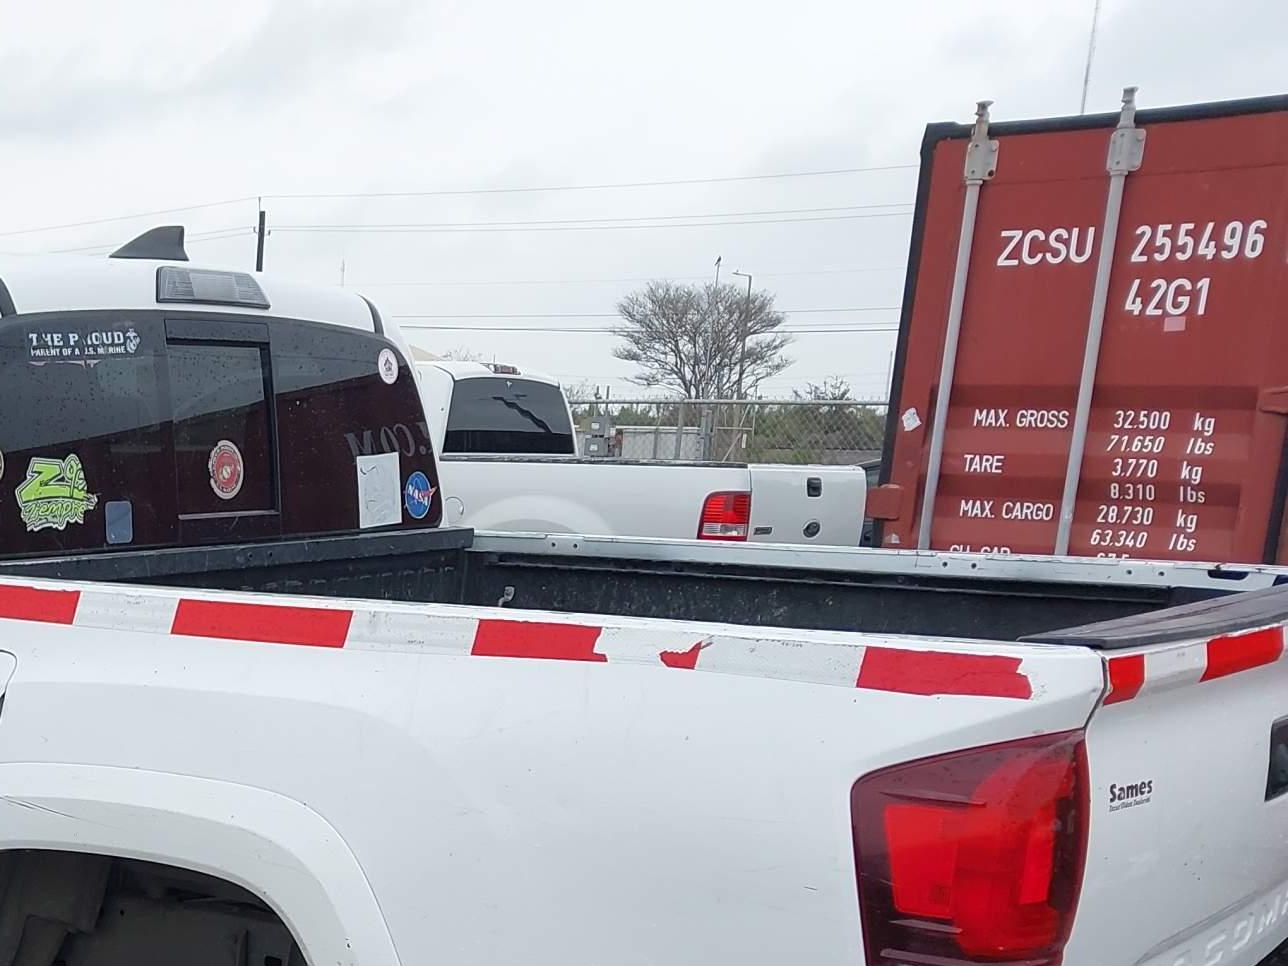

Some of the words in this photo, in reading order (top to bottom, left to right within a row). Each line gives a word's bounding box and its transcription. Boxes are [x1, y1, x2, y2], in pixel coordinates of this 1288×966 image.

[996, 226, 1096, 267] ZCSU
[1130, 219, 1268, 263] 255496
[1124, 277, 1211, 316] 42G1
[972, 408, 1010, 428] MAX.
[1015, 409, 1070, 429] GROSS
[1113, 410, 1171, 430] 32.500
[1193, 412, 1215, 436] kg
[1106, 434, 1165, 453] 71.650
[1186, 437, 1215, 455] lbs
[963, 454, 1005, 473] TARE
[1111, 458, 1158, 478] 3.770
[1180, 460, 1203, 485] kg
[407, 483, 429, 506] NASA
[1110, 482, 1155, 501] 8.310
[1179, 485, 1206, 504] lbs
[959, 499, 995, 518] MAX.
[1001, 501, 1054, 521] CARGO
[1096, 504, 1154, 526] 28.730
[1176, 508, 1198, 533] kg
[1090, 529, 1148, 549] 63.340
[1168, 533, 1197, 551] lbs
[1109, 779, 1153, 804] Sames
